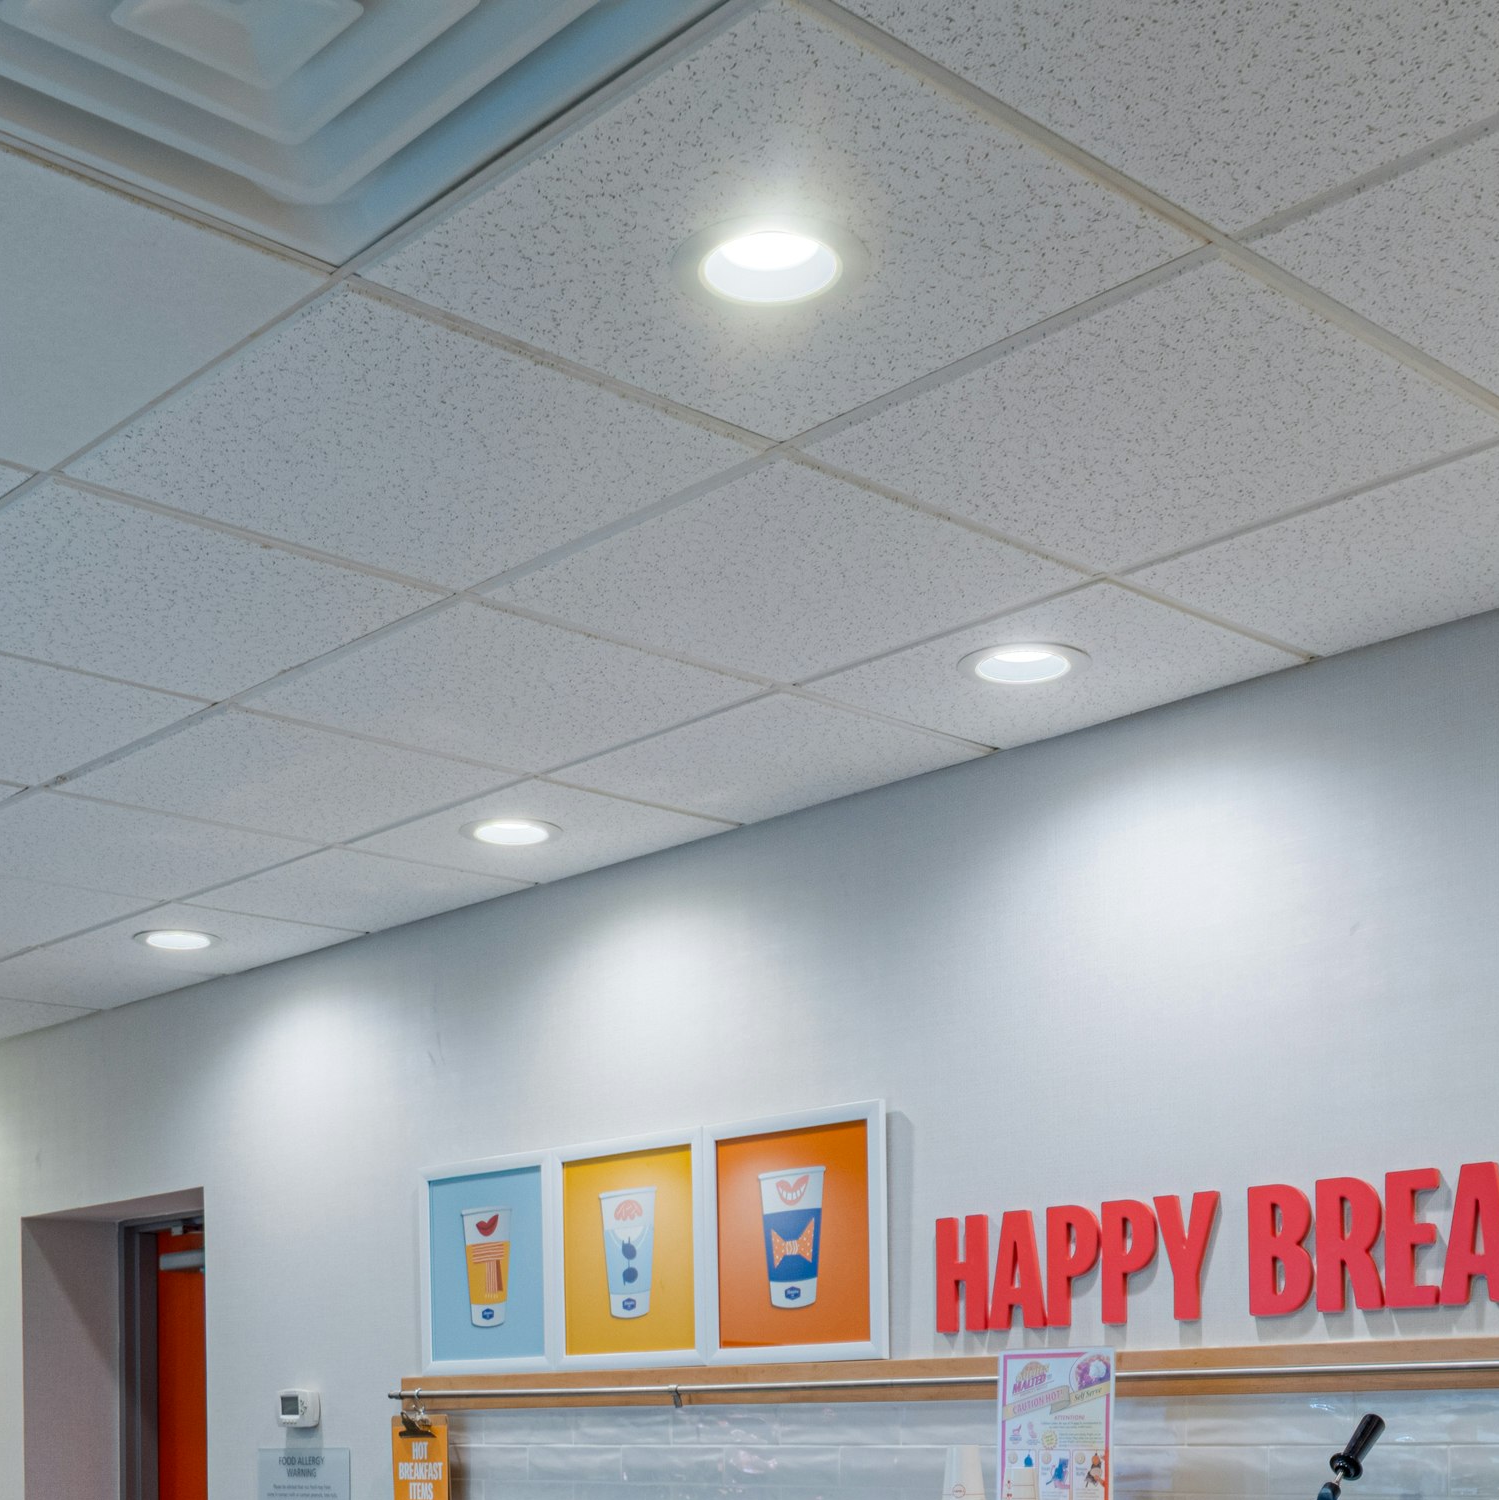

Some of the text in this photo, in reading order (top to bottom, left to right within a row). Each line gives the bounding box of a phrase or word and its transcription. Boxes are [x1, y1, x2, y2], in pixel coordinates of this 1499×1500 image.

[935, 1190, 1220, 1333] HAPPY
[1012, 1398, 1044, 1414] CAUTION
[412, 1441, 428, 1460] HOT
[278, 1456, 325, 1466] FOOD ALLERGY
[286, 1468, 316, 1478] WARNING
[398, 1462, 443, 1480] BREAKFAST
[409, 1482, 434, 1500] ITEMS
